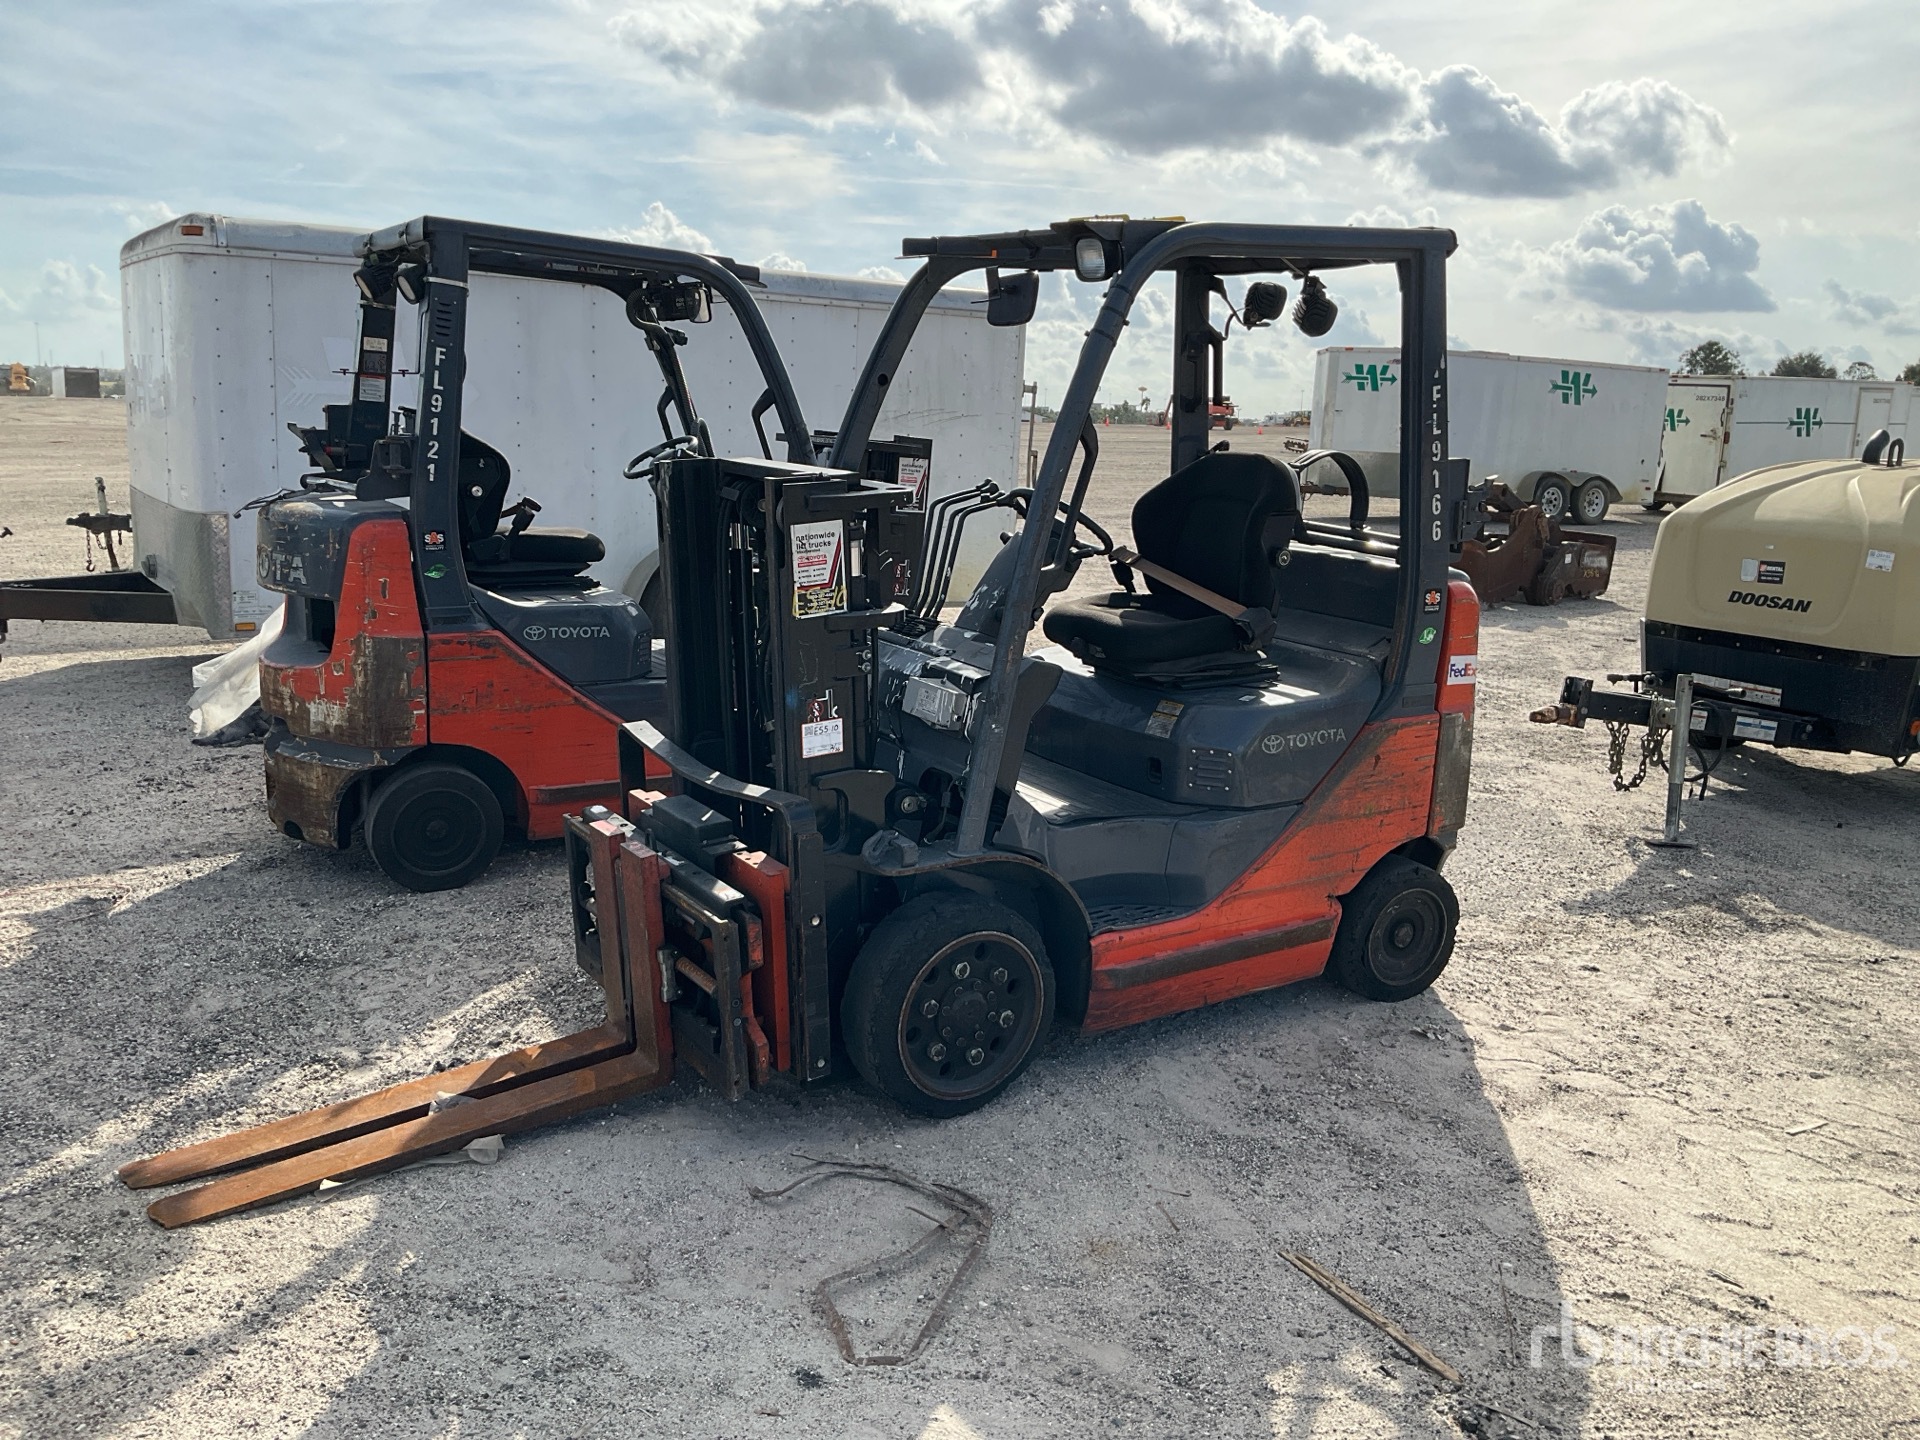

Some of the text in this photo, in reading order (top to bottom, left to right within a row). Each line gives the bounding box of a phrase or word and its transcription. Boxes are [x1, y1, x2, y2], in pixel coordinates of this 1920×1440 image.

[427, 348, 446, 482] FL9121
[1728, 590, 1812, 613] DOOSAN
[548, 626, 611, 639] TOYOTA
[1286, 728, 1346, 749] TOYOTA
